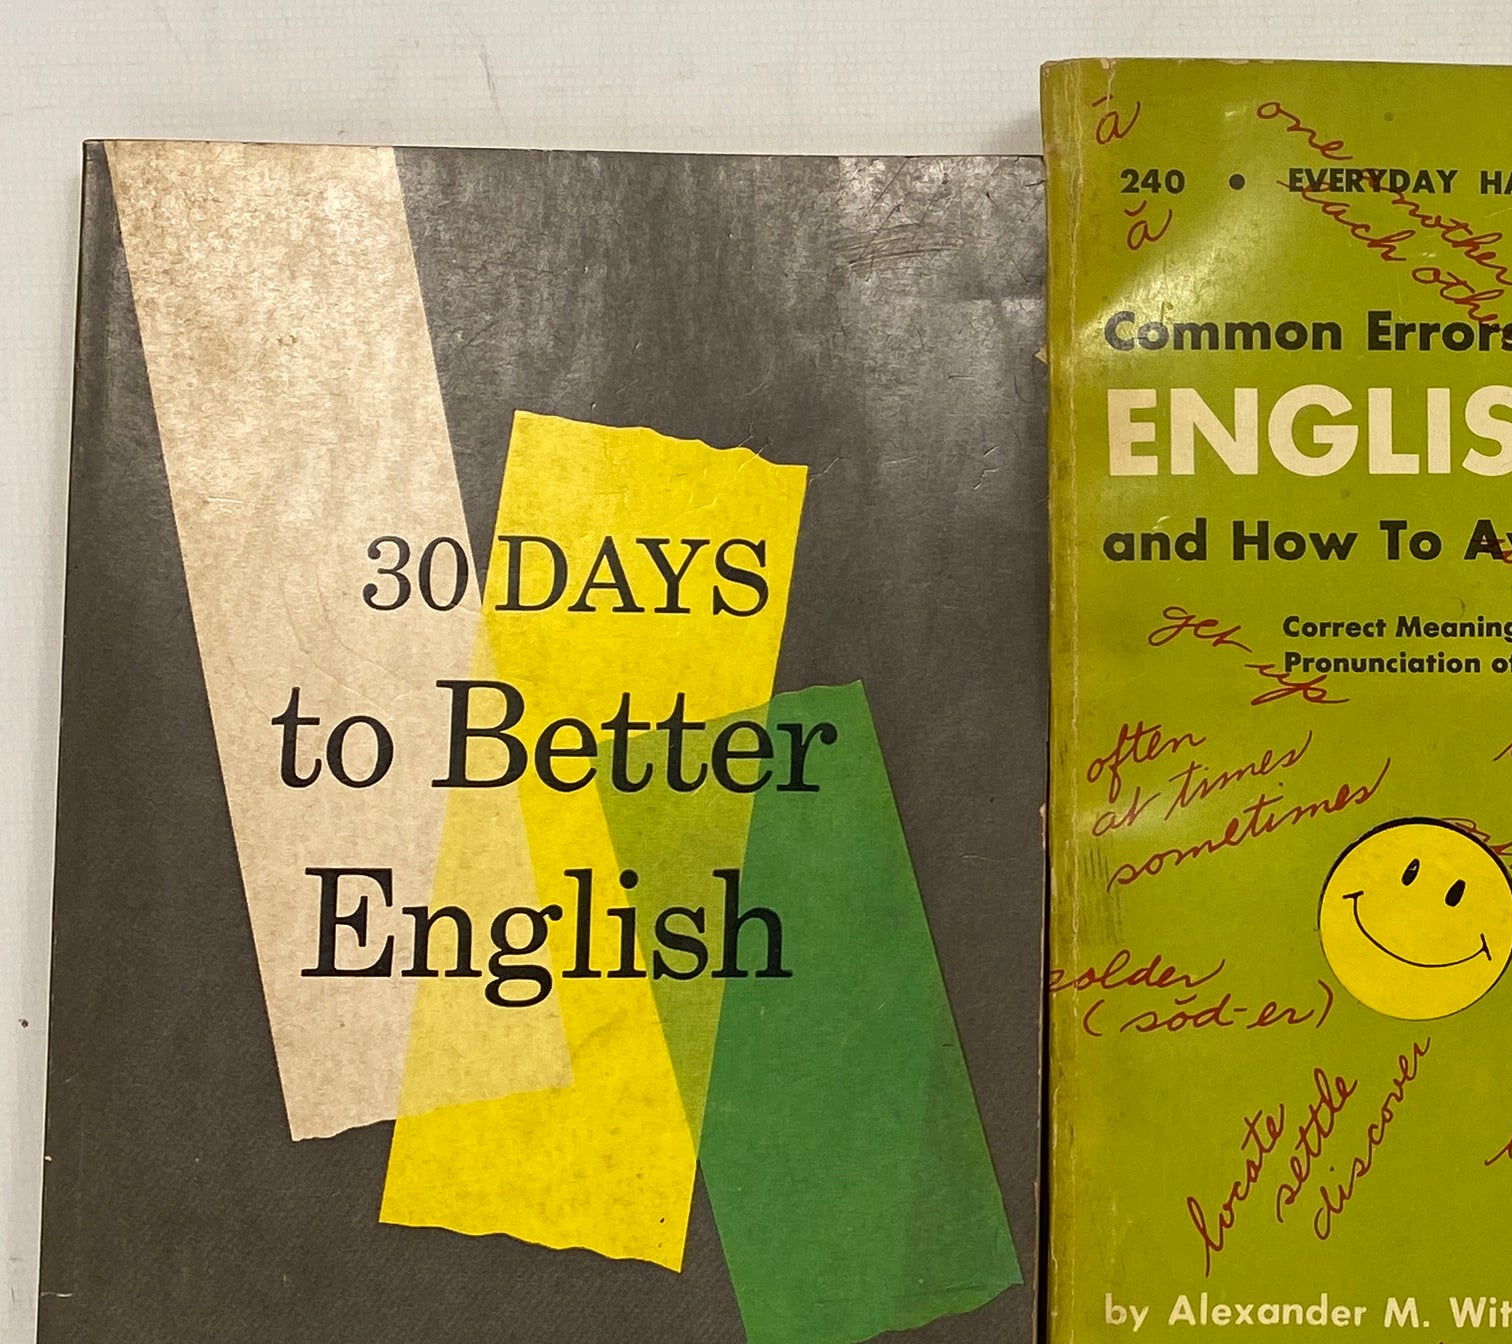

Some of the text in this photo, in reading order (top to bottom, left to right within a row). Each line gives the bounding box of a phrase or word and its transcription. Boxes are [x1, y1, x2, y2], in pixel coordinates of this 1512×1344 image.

[1256, 101, 1354, 161] one
[1119, 168, 1186, 194] 240
[1289, 168, 1458, 194] EVERYDAY
[1104, 311, 1342, 351] Common
[362, 535, 771, 617] 30 DAYS
[1102, 517, 1207, 562] and
[1232, 519, 1358, 561] How
[1380, 519, 1442, 561] To
[1283, 615, 1387, 638] Correct
[1284, 651, 1481, 674] Pronunciation
[271, 679, 838, 794] to Better
[1086, 720, 1207, 802] often
[1091, 729, 1313, 837] at times
[1106, 757, 1391, 894] sometimes
[300, 868, 793, 1008] English
[1276, 1067, 1359, 1224] settle
[1314, 1036, 1431, 1241] discover
[1186, 1102, 1285, 1278] locate
[1104, 1292, 1149, 1333] by
[1168, 1293, 1367, 1328] Alexander
[1383, 1296, 1431, 1329] M.
